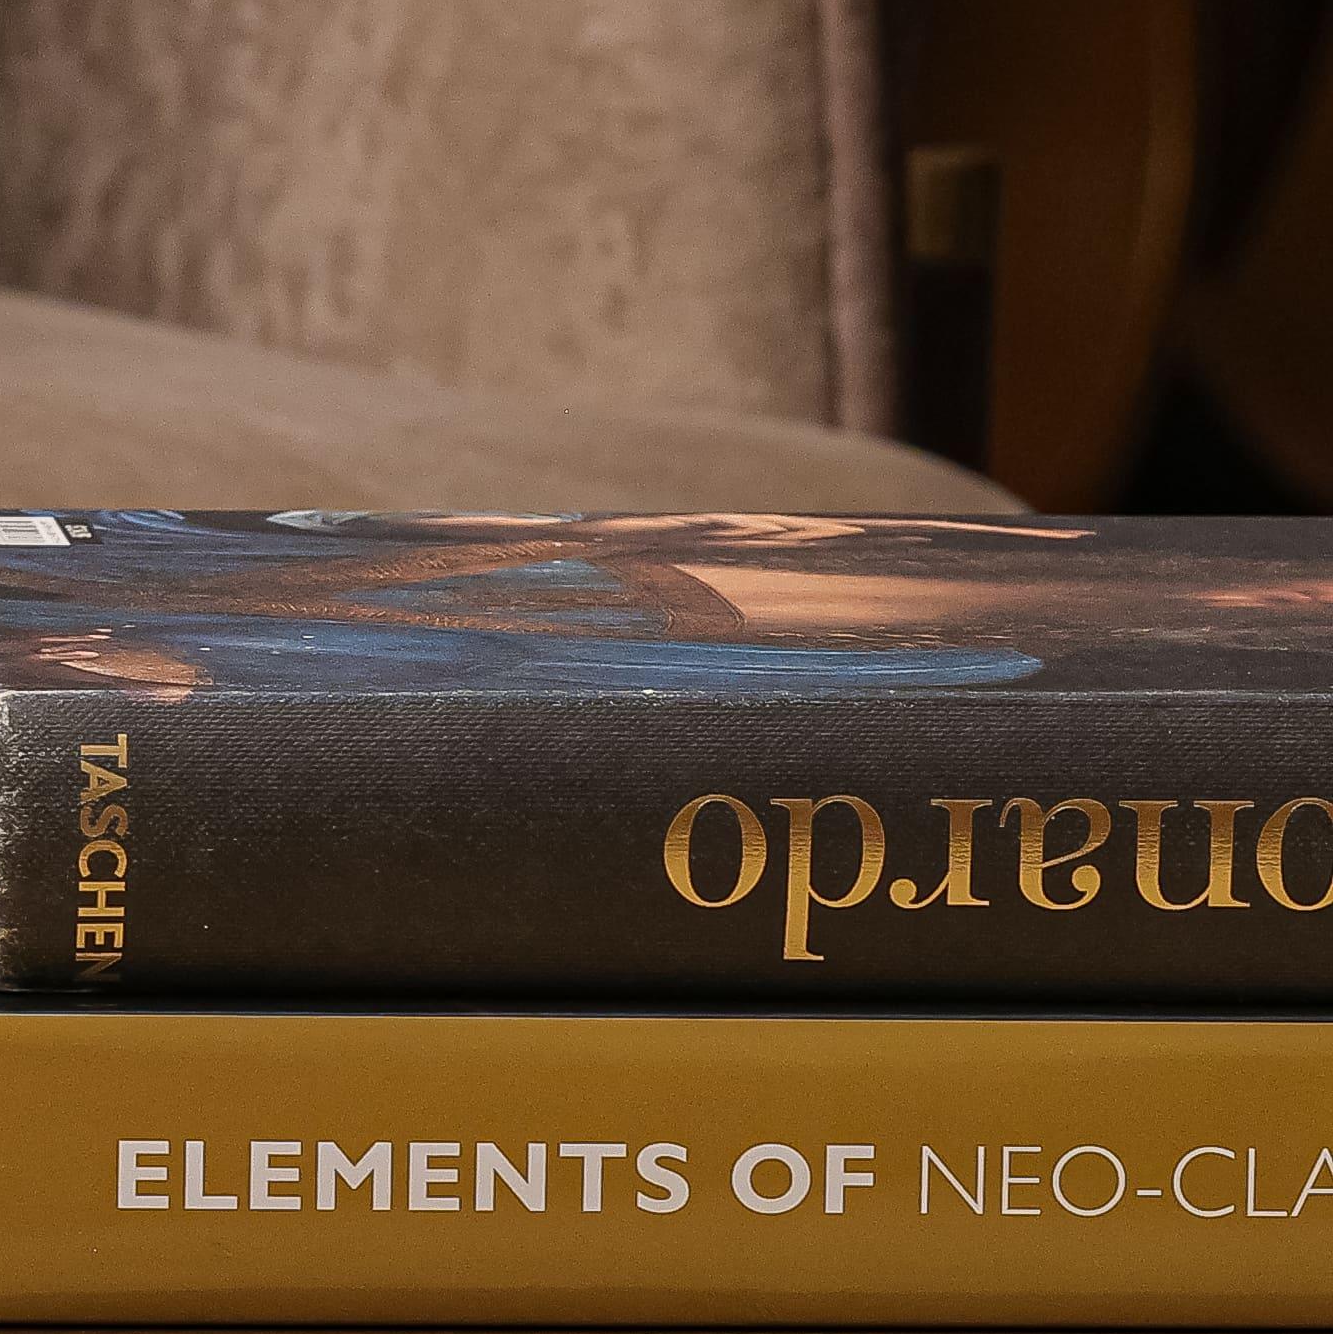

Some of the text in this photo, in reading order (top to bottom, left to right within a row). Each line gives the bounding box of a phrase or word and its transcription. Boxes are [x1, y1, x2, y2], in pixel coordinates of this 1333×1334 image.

[76, 733, 128, 982] TASCHEN
[664, 794, 1333, 961] onardo
[117, 1140, 1333, 1217] ELEMENTS OF NEO-CLA
